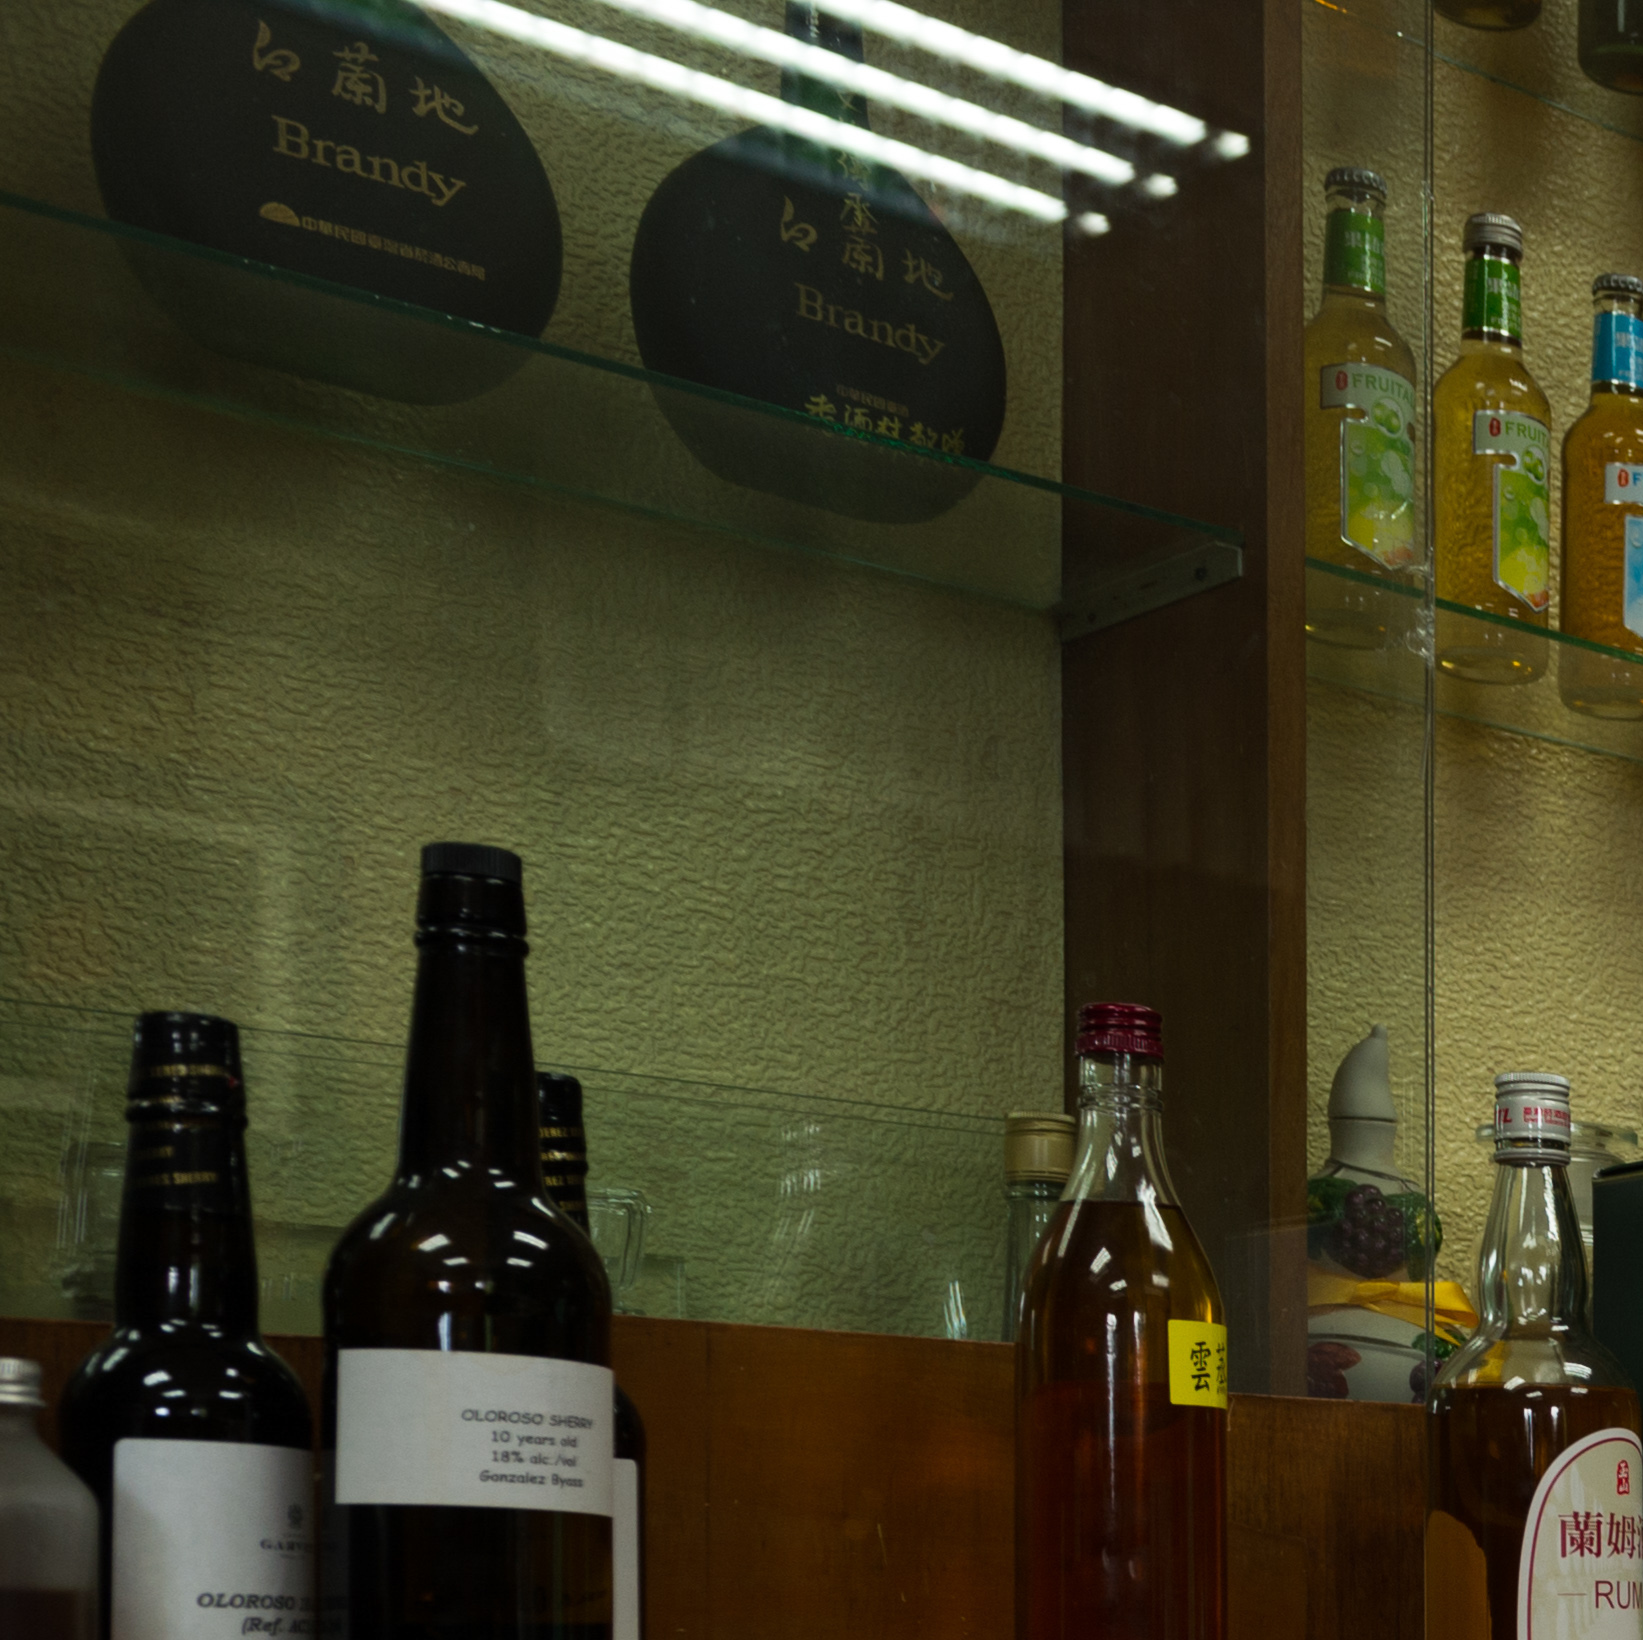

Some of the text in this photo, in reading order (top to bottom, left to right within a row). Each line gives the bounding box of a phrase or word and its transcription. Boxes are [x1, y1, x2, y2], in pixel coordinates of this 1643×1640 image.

[271, 114, 467, 207] Brandy
[794, 282, 946, 366] Brandy
[461, 1408, 593, 1429] OLOROSO SHERRY
[491, 1430, 577, 1448] 10 years old
[492, 1450, 525, 1463] 18%
[479, 1469, 584, 1489] Gonzalez Byass
[196, 1592, 296, 1611] OLOROSO
